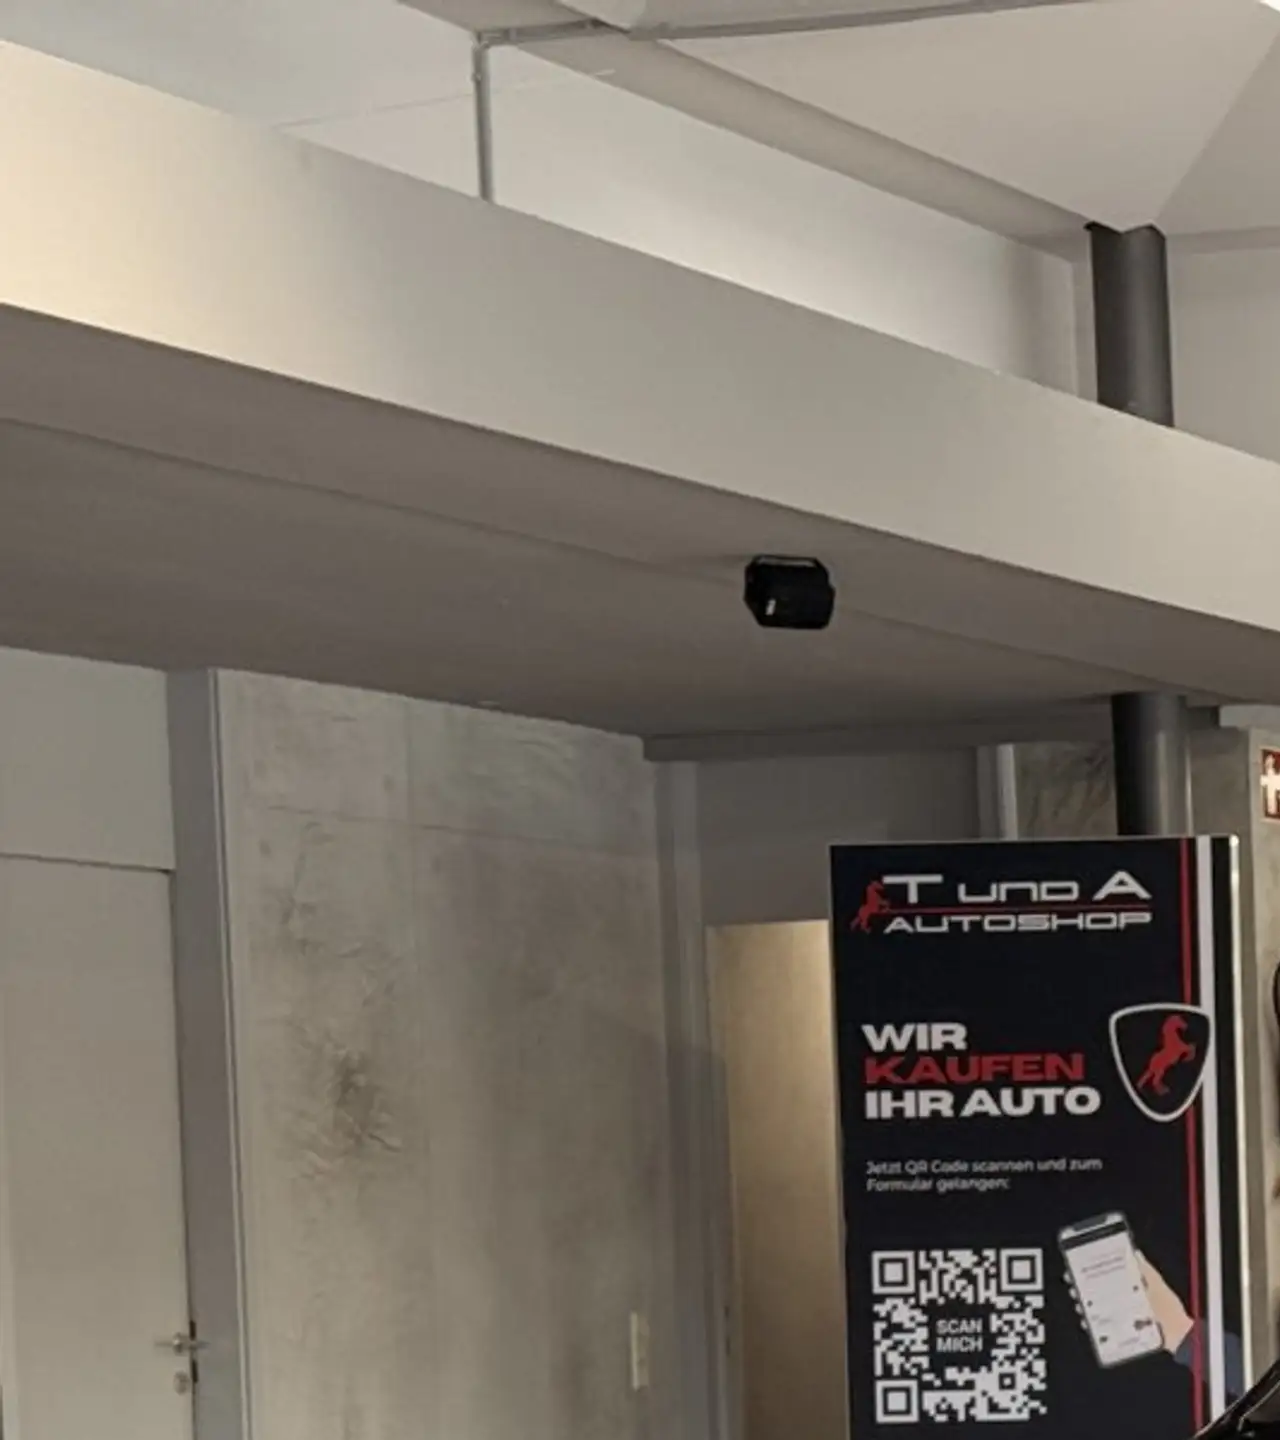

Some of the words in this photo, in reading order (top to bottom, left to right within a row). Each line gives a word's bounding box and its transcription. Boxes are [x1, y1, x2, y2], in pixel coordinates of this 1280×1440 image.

[883, 874, 943, 904] T
[1092, 870, 1152, 900] A
[884, 911, 1153, 934] AUTOSHOP
[862, 1023, 968, 1052] WIR
[864, 1053, 1084, 1085] KAUFEN
[865, 1089, 954, 1120] IHR
[960, 1086, 1102, 1117] AUTO
[866, 1160, 901, 1175] Jetzt
[904, 1159, 928, 1175] QR
[931, 1159, 969, 1174] Code
[972, 1159, 1034, 1173] scannen
[1037, 1157, 1066, 1172] und
[1069, 1158, 1103, 1172] zum
[866, 1177, 933, 1192] Formular
[936, 1318, 983, 1335] SCAN
[936, 1336, 984, 1353] MICH
